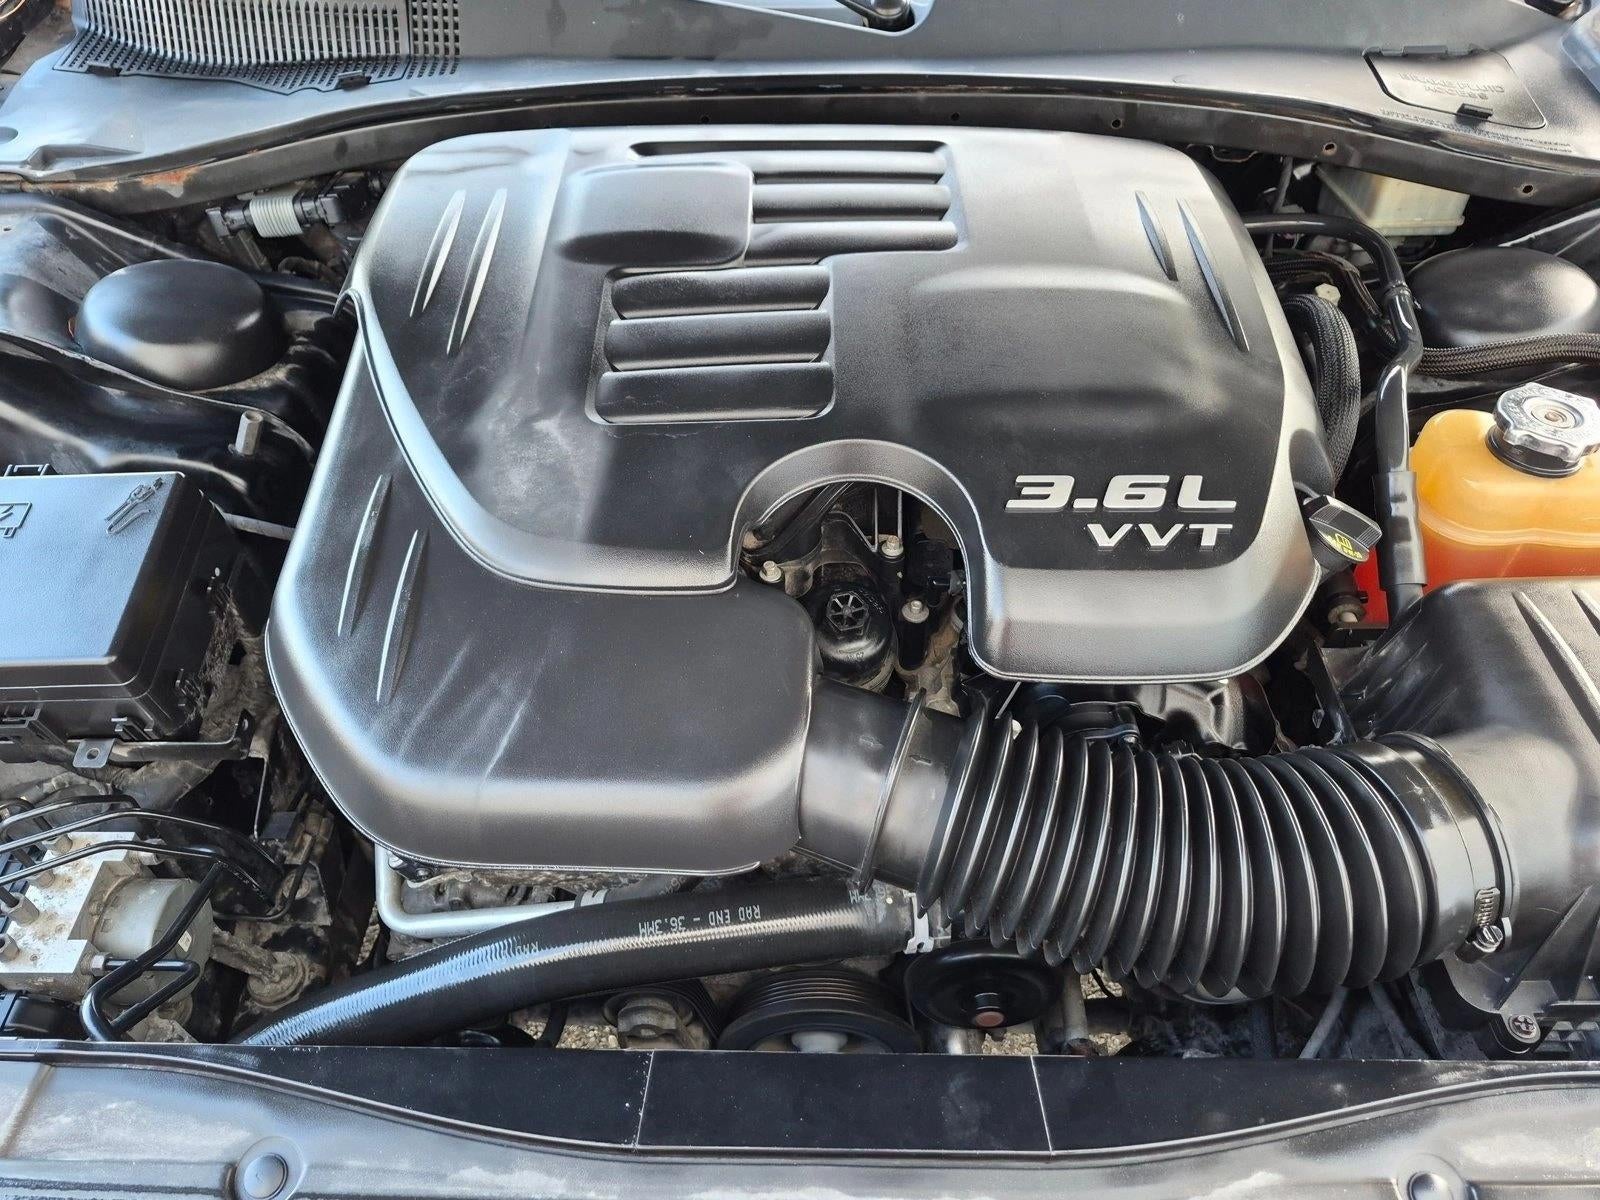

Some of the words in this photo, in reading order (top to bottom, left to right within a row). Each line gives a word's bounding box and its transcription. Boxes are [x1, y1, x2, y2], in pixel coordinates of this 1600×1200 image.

[1005, 475, 1237, 512] 3.6L
[1086, 523, 1233, 550] VVT
[708, 909, 730, 926] END
[738, 905, 760, 921] RAD
[639, 916, 686, 937] 36.3MM
